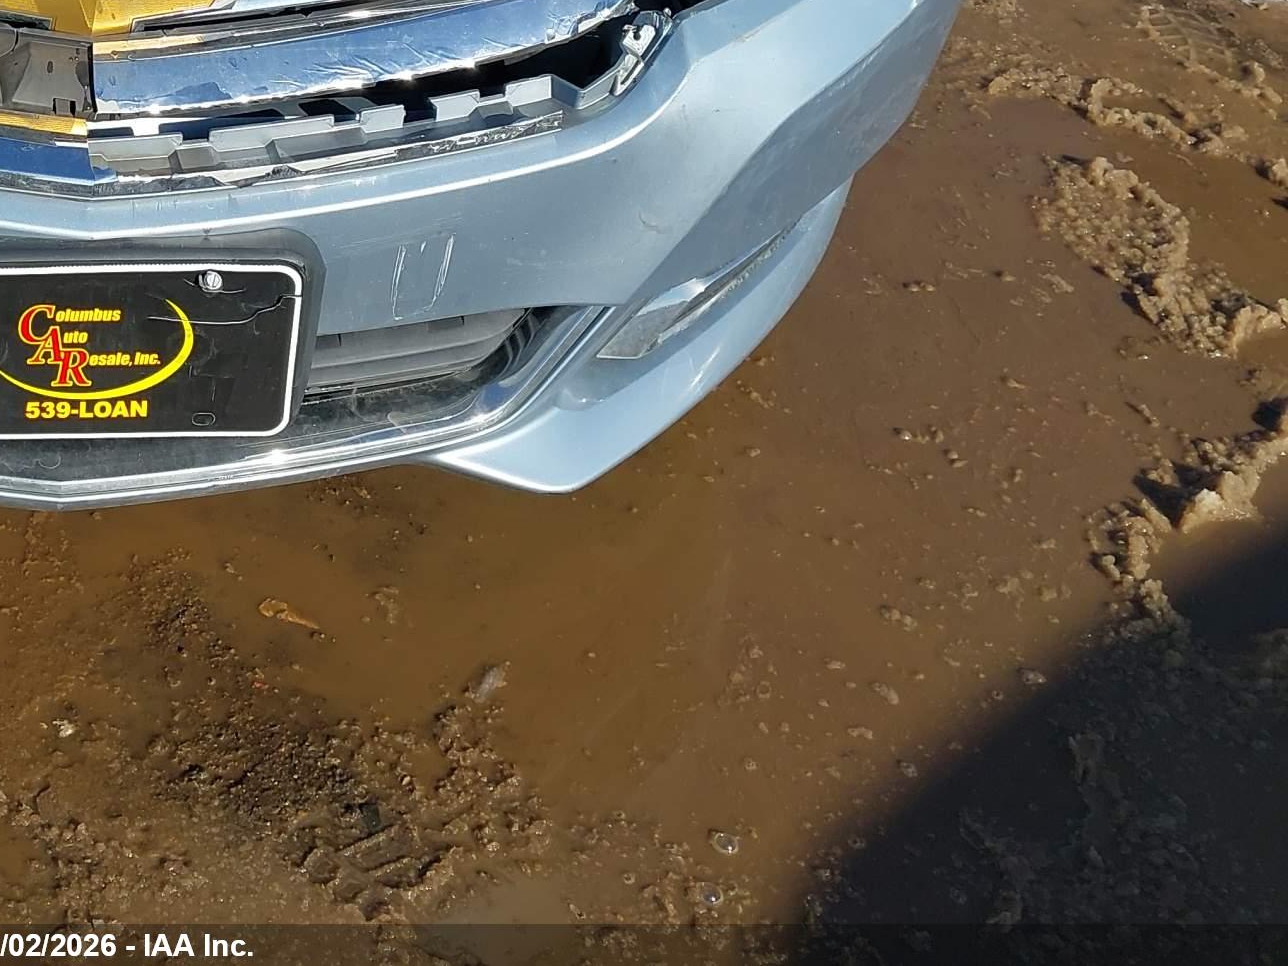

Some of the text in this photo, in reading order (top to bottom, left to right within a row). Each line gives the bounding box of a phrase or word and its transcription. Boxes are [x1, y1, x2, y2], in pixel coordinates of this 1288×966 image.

[18, 304, 121, 345] Columbus
[26, 325, 89, 365] Auto
[50, 347, 161, 387] Resale, Inc.
[24, 399, 149, 420] 539-LOAN
